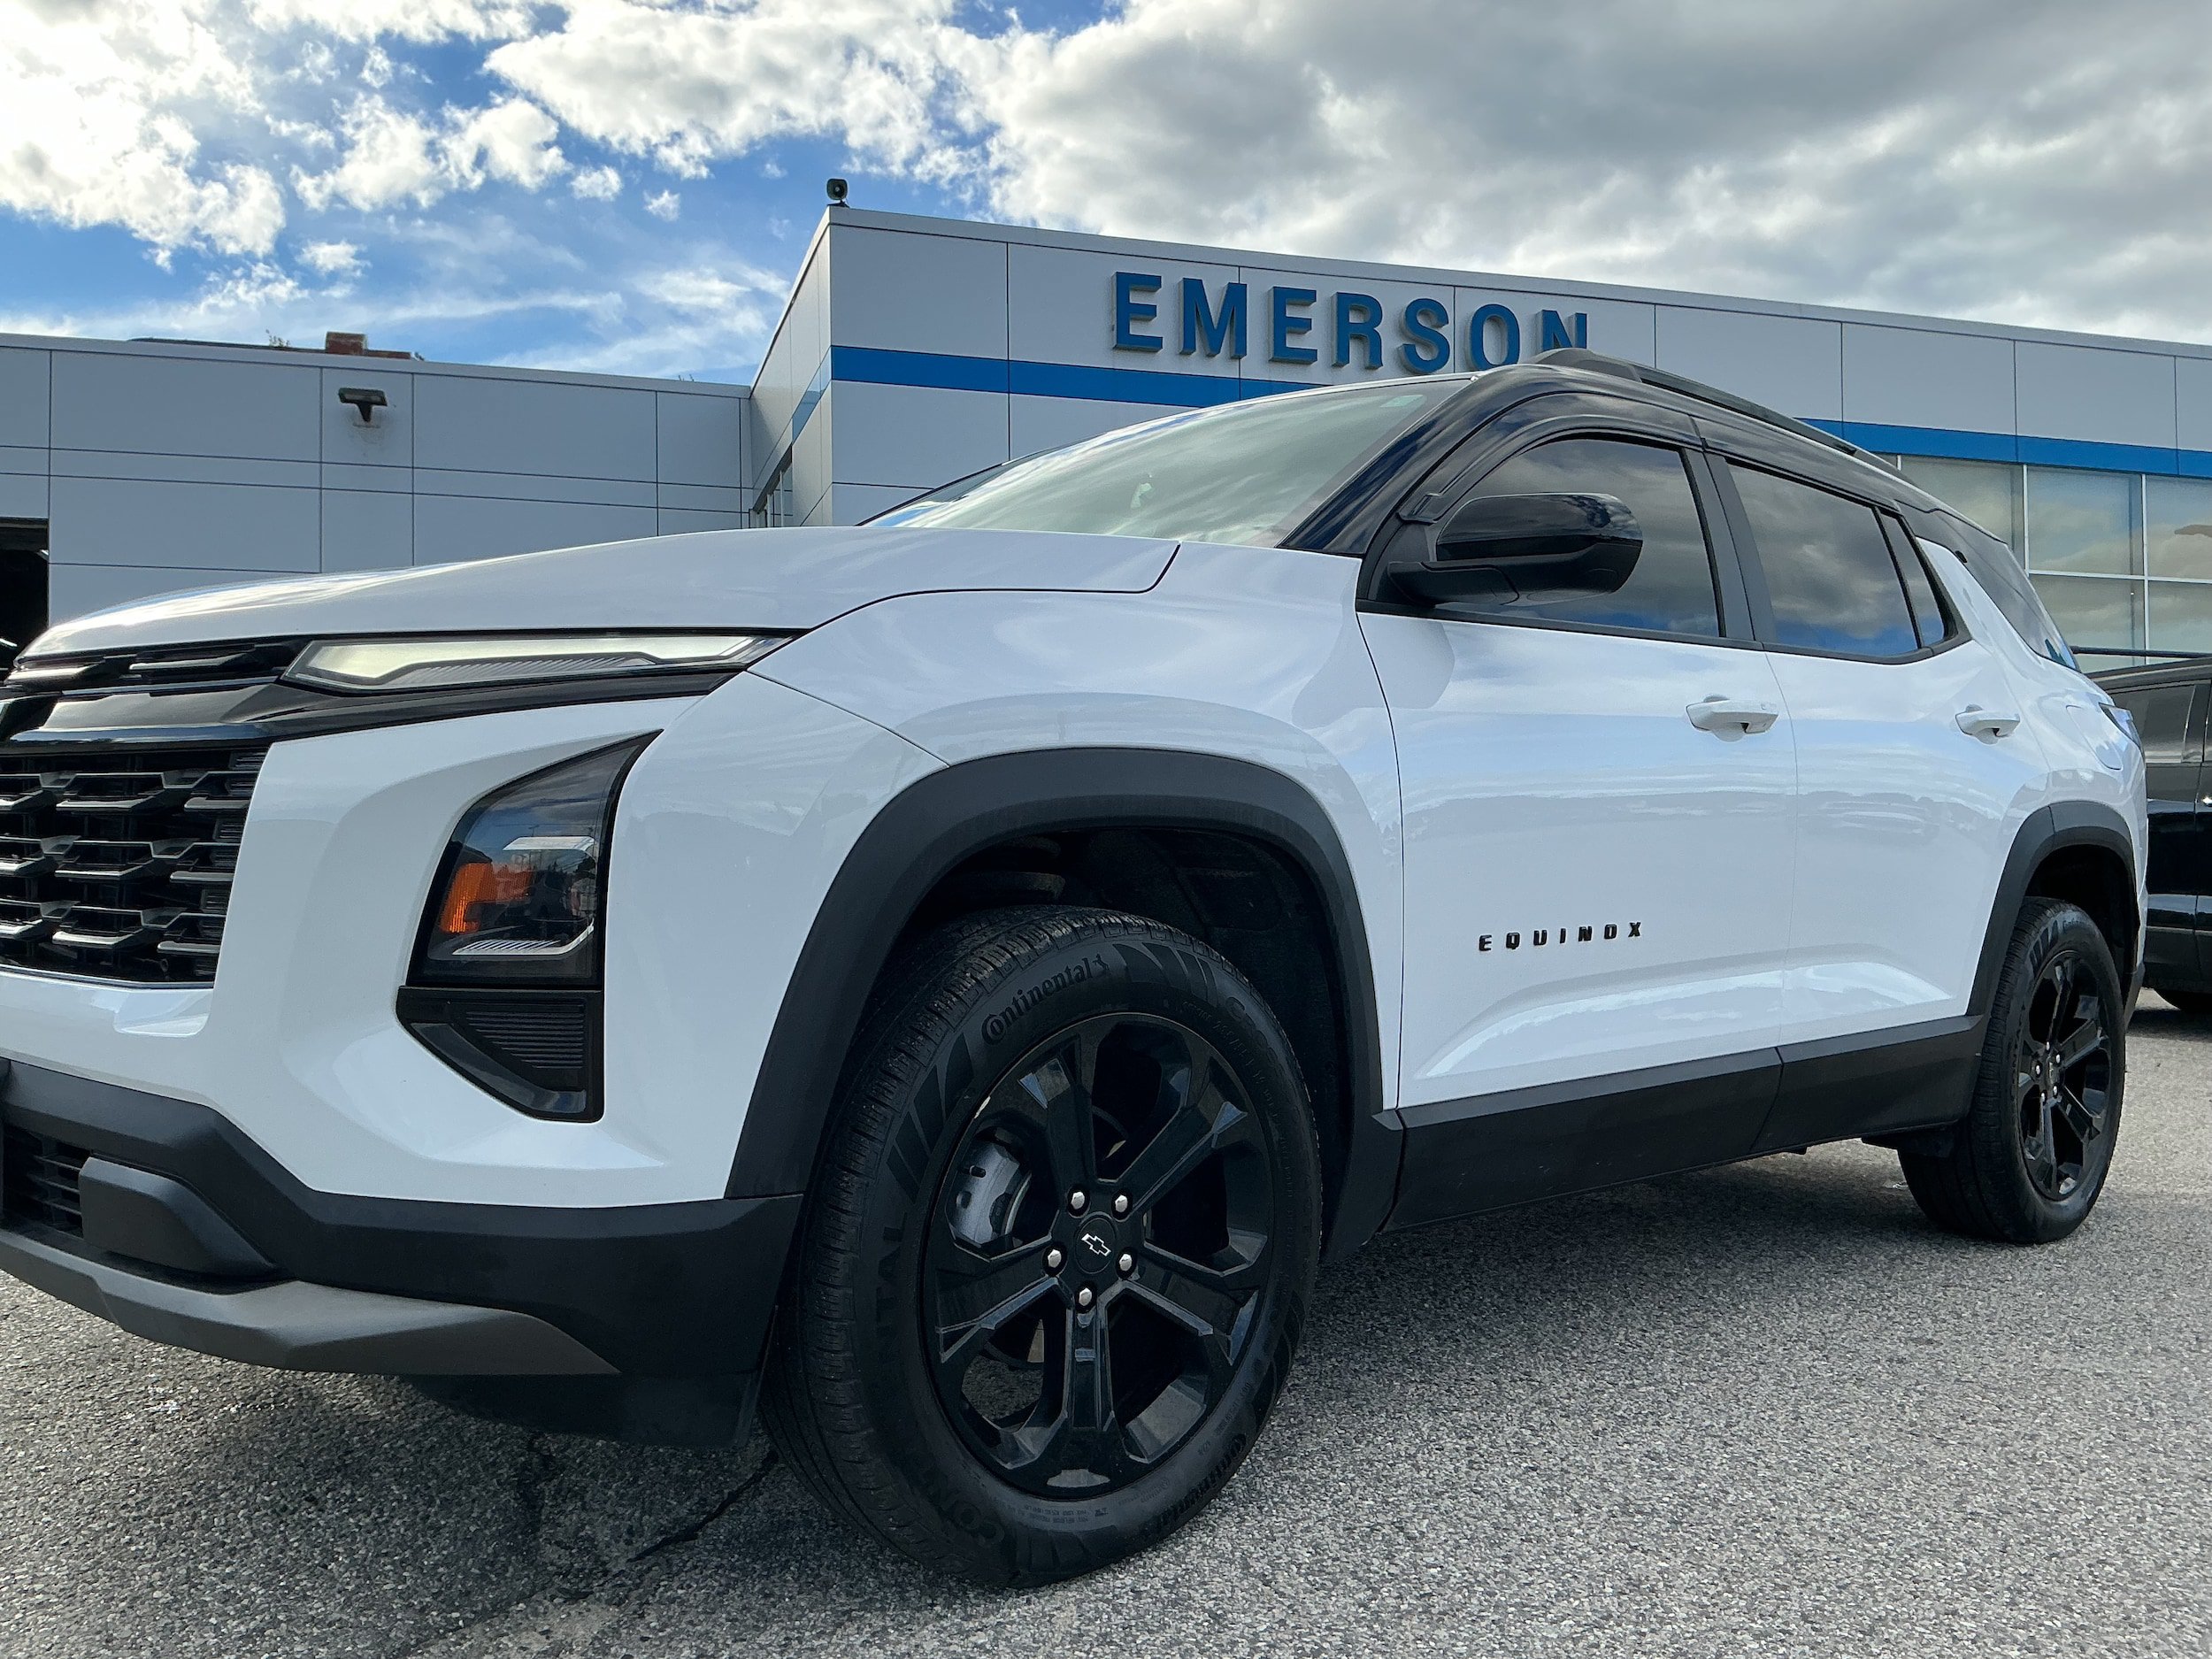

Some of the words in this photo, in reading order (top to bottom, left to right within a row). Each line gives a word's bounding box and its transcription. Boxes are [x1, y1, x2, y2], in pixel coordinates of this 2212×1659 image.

[1112, 271, 1588, 374] EMERSON
[1478, 922, 1641, 952] EQUINOX
[981, 956, 1094, 1046] Continental
